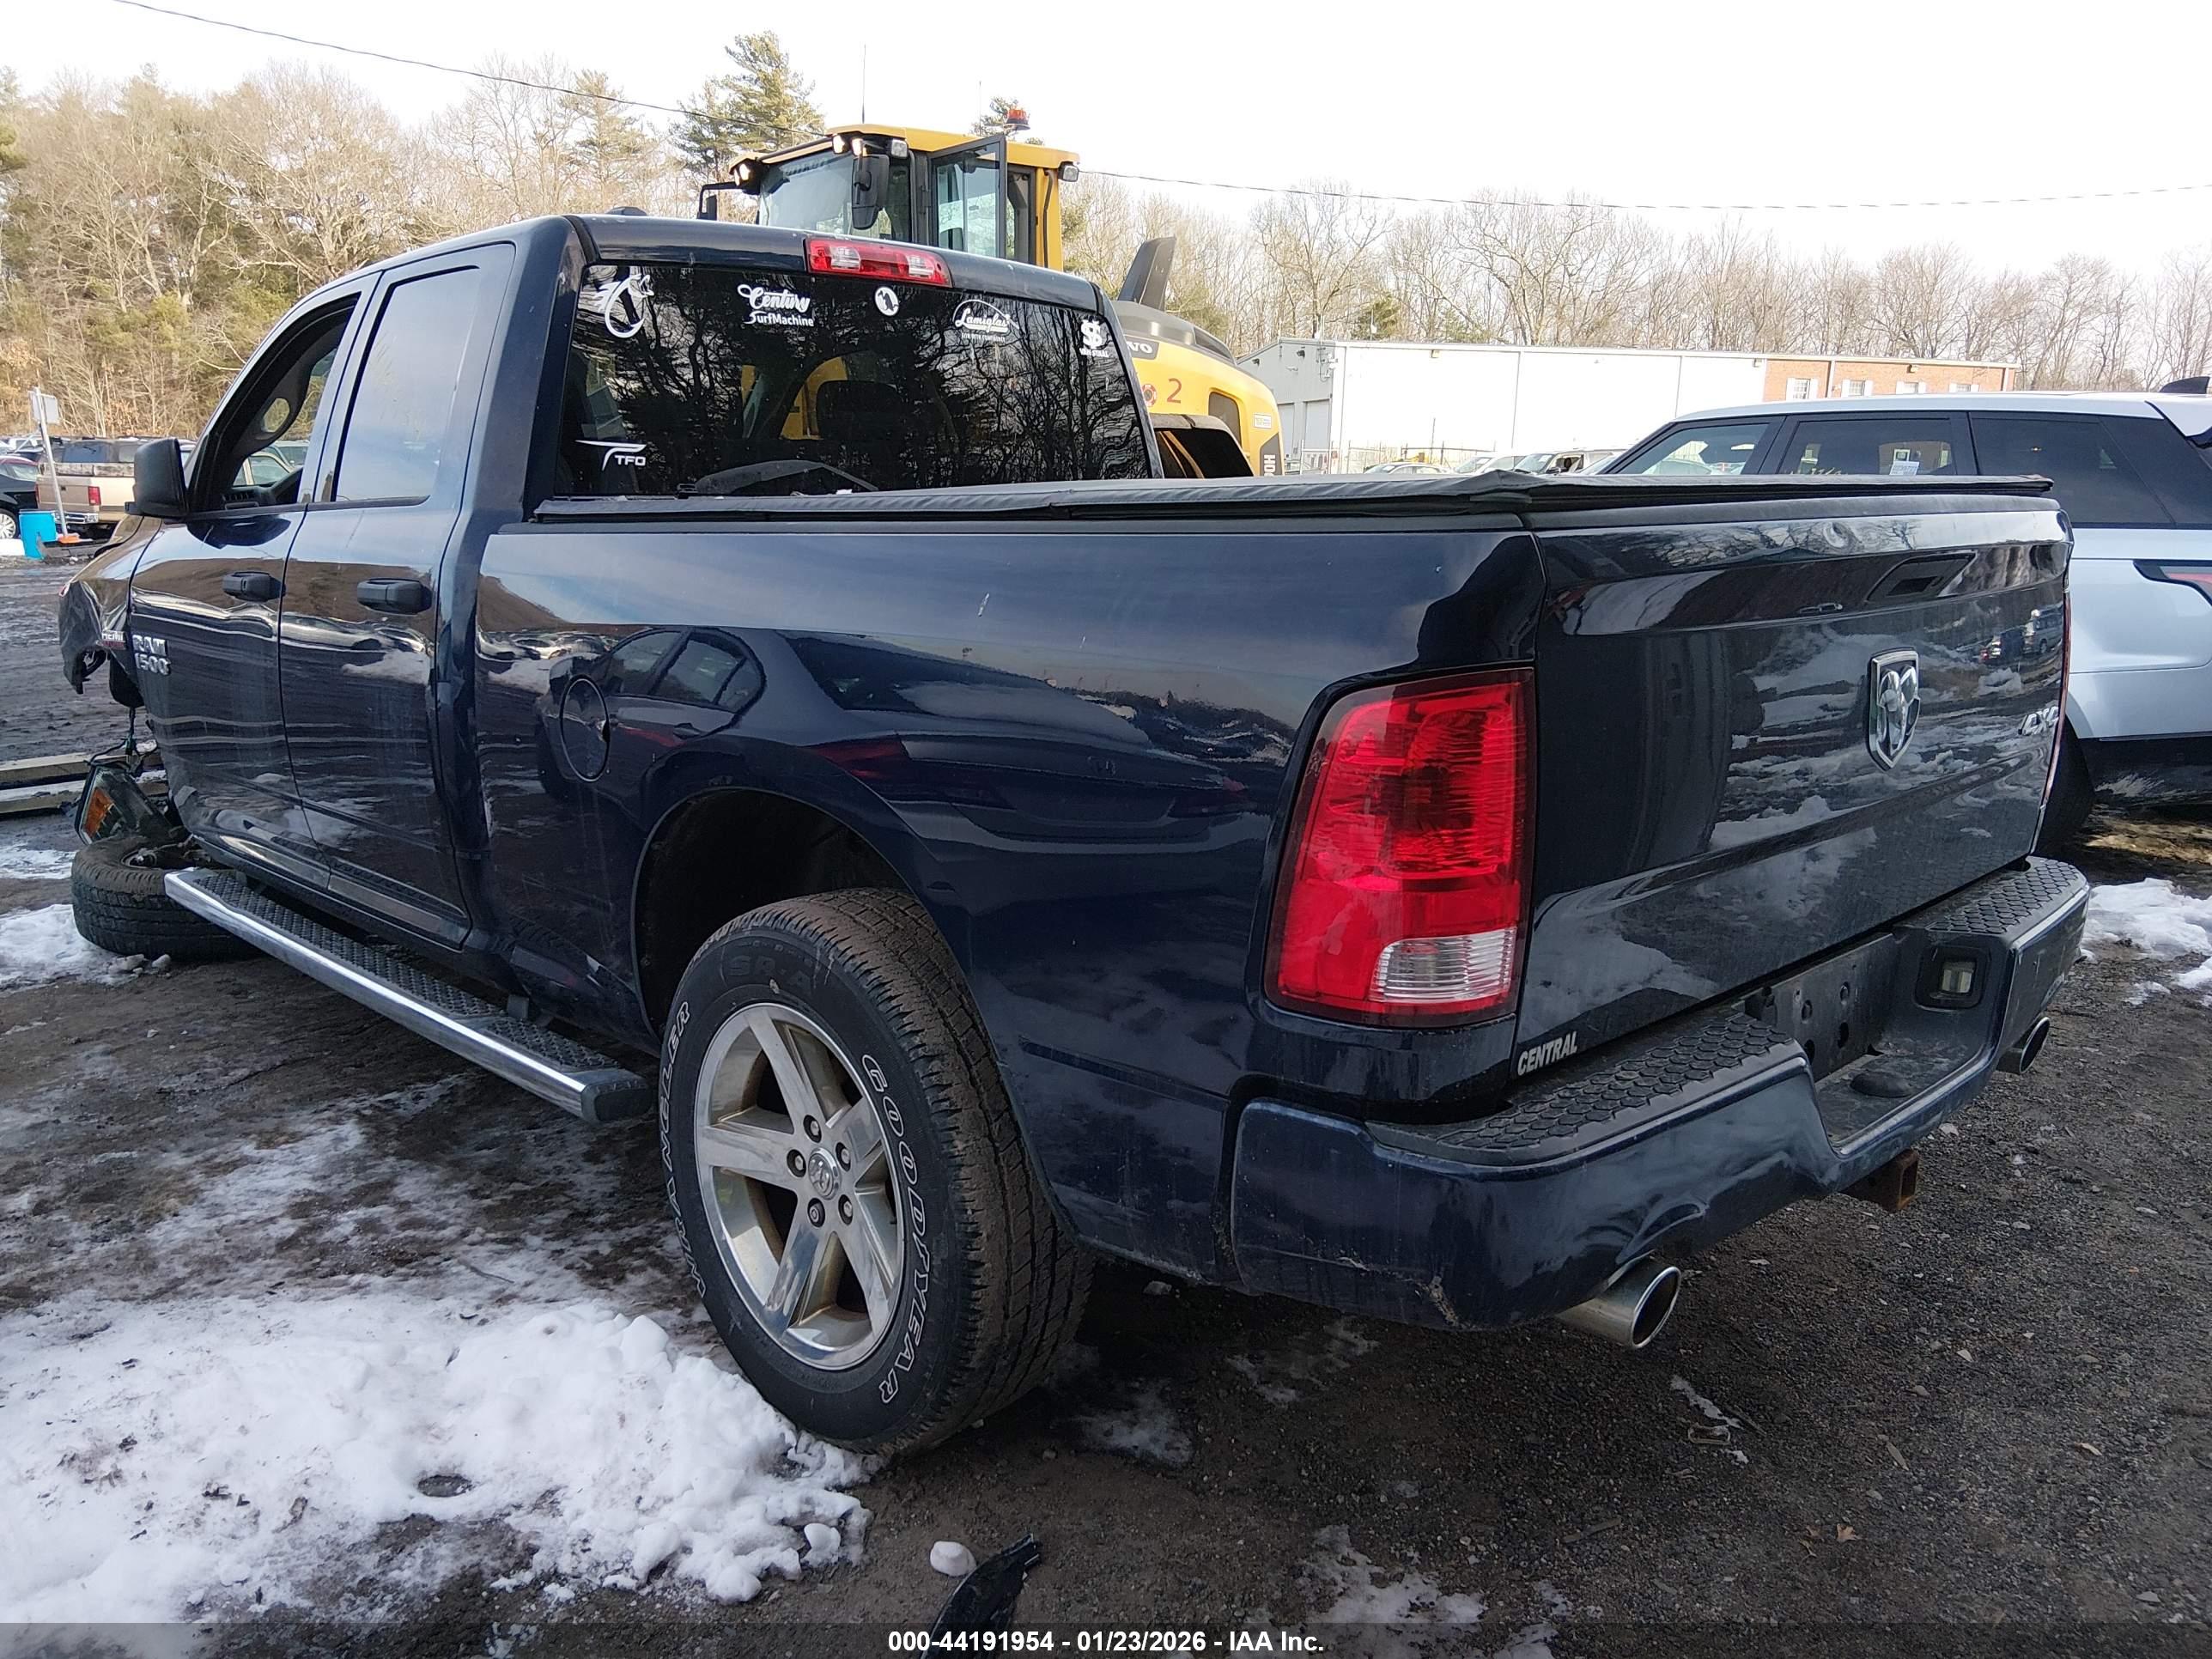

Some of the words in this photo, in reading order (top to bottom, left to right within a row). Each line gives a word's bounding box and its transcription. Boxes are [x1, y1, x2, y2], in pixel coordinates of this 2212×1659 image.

[737, 284, 811, 313] Century
[743, 310, 815, 326] SurfMachine
[1166, 378, 1182, 404] 2
[614, 454, 646, 466] TFO
[132, 634, 167, 656] RAM
[134, 653, 171, 676] 1500
[1516, 1030, 1578, 1077] CENTRAL
[659, 1000, 707, 1299] WRANGLER
